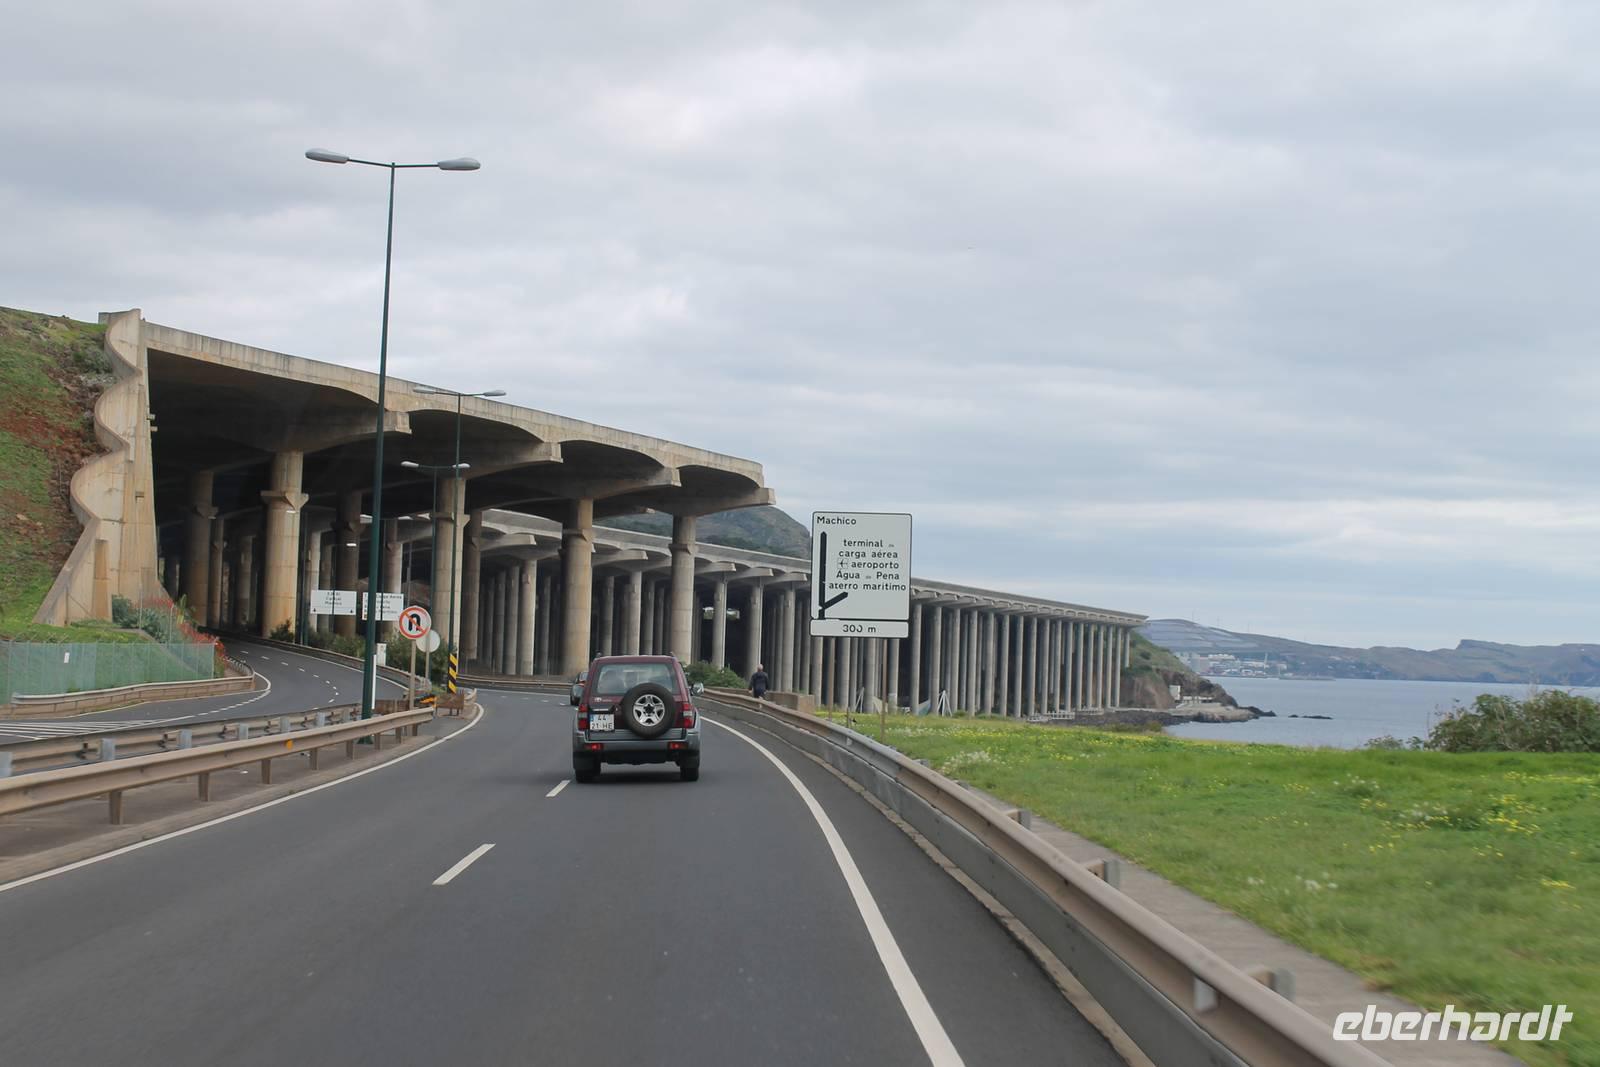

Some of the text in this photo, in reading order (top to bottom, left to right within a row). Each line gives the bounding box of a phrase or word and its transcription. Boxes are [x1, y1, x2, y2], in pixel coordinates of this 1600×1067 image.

[816, 516, 857, 525] Machico
[843, 539, 883, 548] terminal
[838, 550, 898, 559] carga aérea
[851, 561, 900, 570] aeroporto
[876, 571, 900, 580] Pena
[828, 582, 859, 590] aterro
[842, 624, 863, 633] 300
